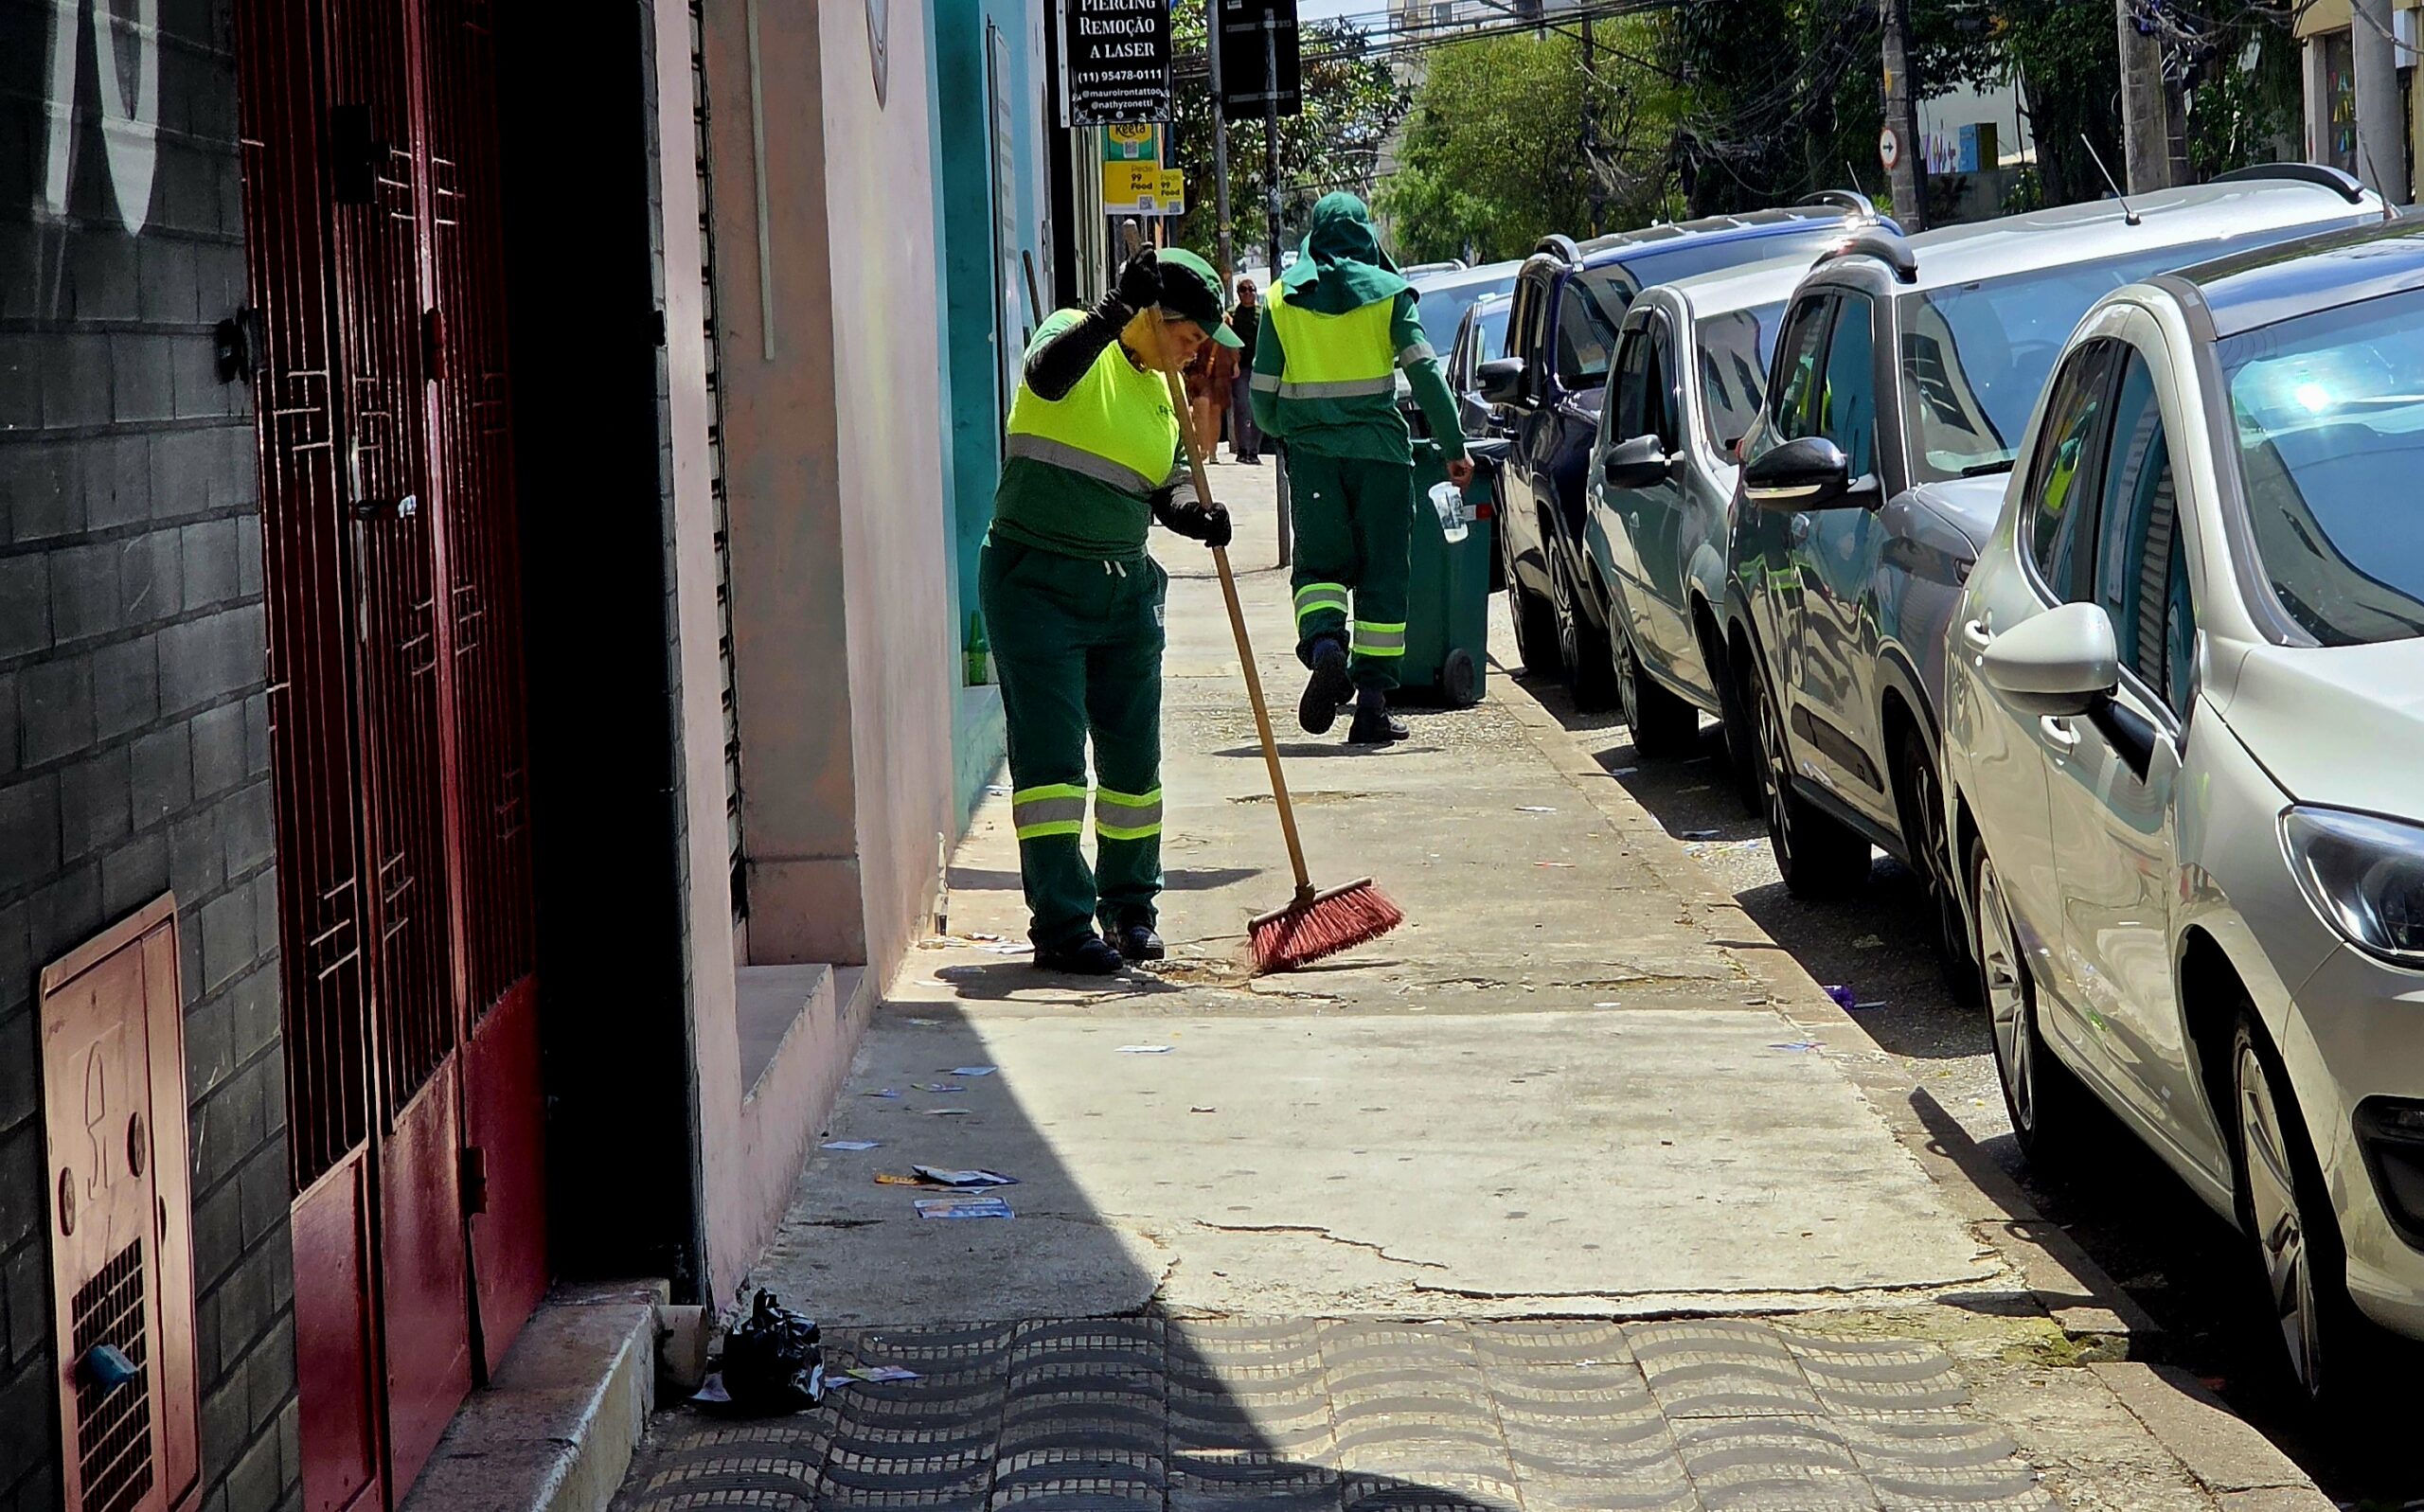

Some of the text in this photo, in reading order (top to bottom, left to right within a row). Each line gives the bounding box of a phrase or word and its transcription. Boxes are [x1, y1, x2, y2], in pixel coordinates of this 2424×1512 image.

[1104, 42, 1155, 59] LASER
[1078, 68, 1162, 84] (11) 95478-0111
[1091, 98, 1153, 110] @nathyzonetti
[1131, 173, 1143, 182] 99
[1131, 182, 1153, 190] Food
